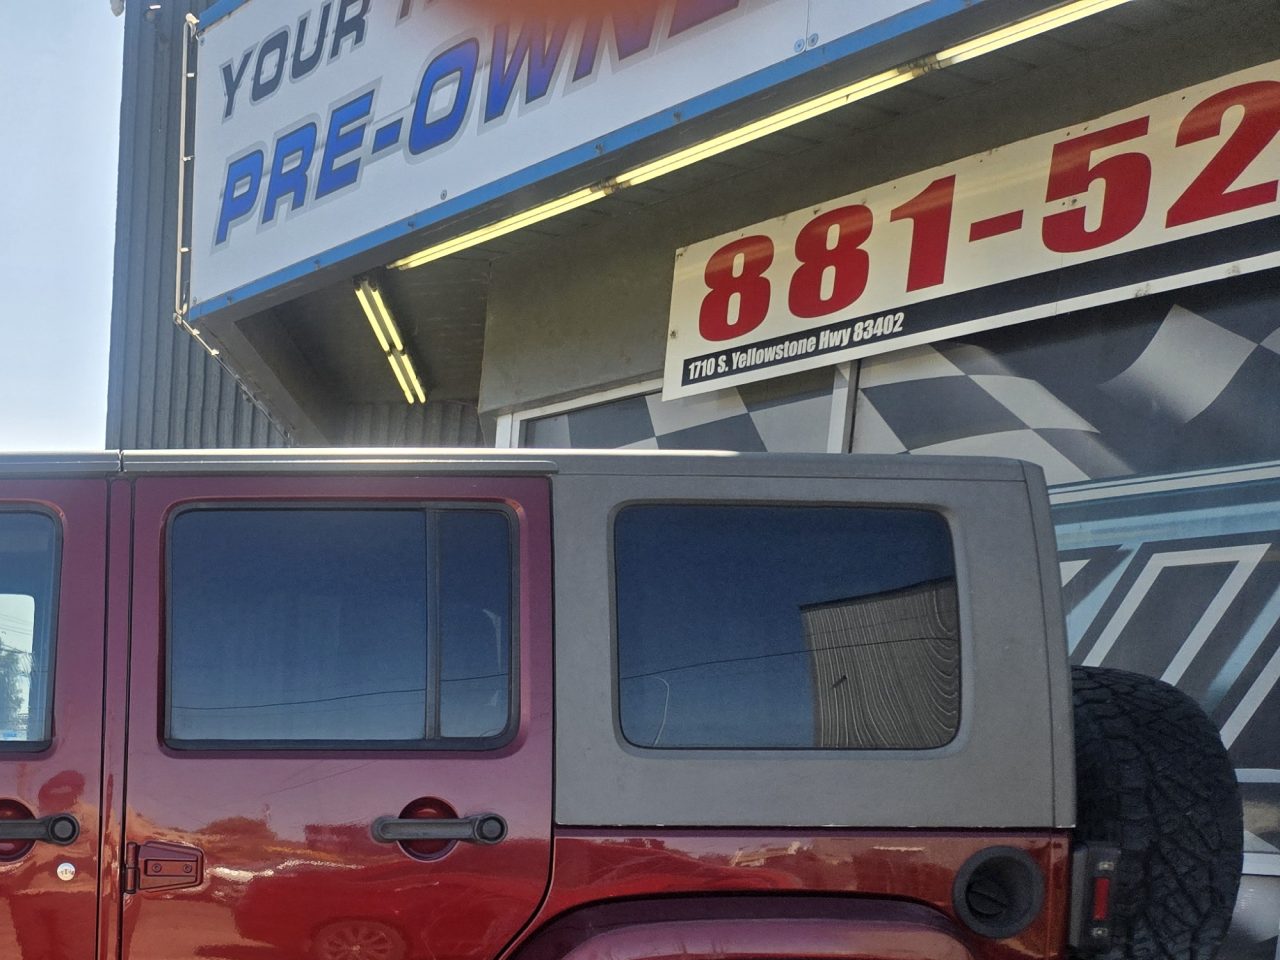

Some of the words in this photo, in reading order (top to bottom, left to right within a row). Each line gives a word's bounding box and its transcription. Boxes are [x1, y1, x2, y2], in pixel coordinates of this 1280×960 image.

[215, 0, 742, 246] PRE-OWN
[222, 0, 371, 119] YOUR
[698, 80, 1280, 342] 881-52
[688, 357, 716, 380] 1710
[717, 357, 729, 374] S.
[731, 336, 816, 371] Yellowstone
[818, 327, 852, 350] Hwy
[852, 312, 905, 342] 83402
